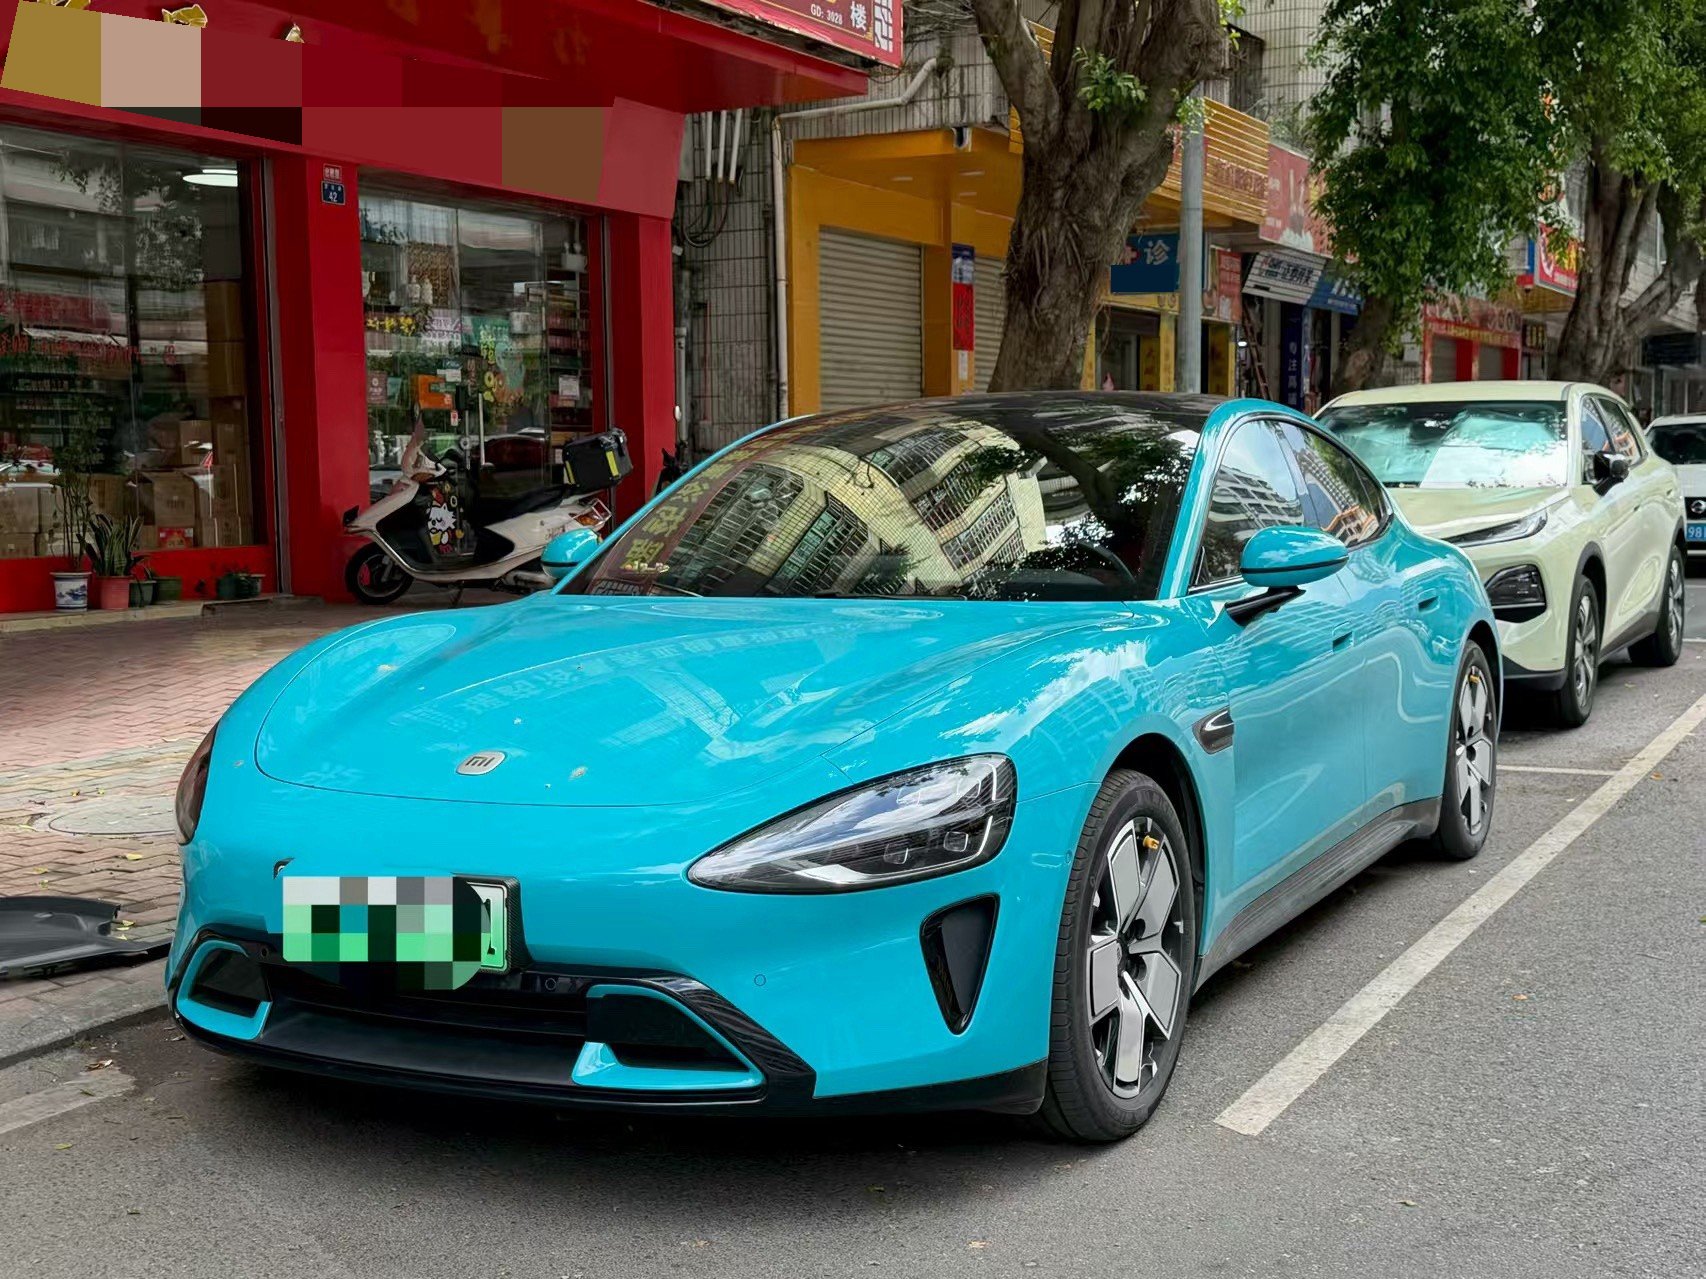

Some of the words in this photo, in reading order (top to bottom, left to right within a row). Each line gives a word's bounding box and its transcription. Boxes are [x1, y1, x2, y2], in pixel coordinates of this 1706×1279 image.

[811, 4, 824, 18] GD:
[850, 1, 867, 31] 楼
[328, 191, 338, 202] 42
[1688, 527, 1706, 538] 98
